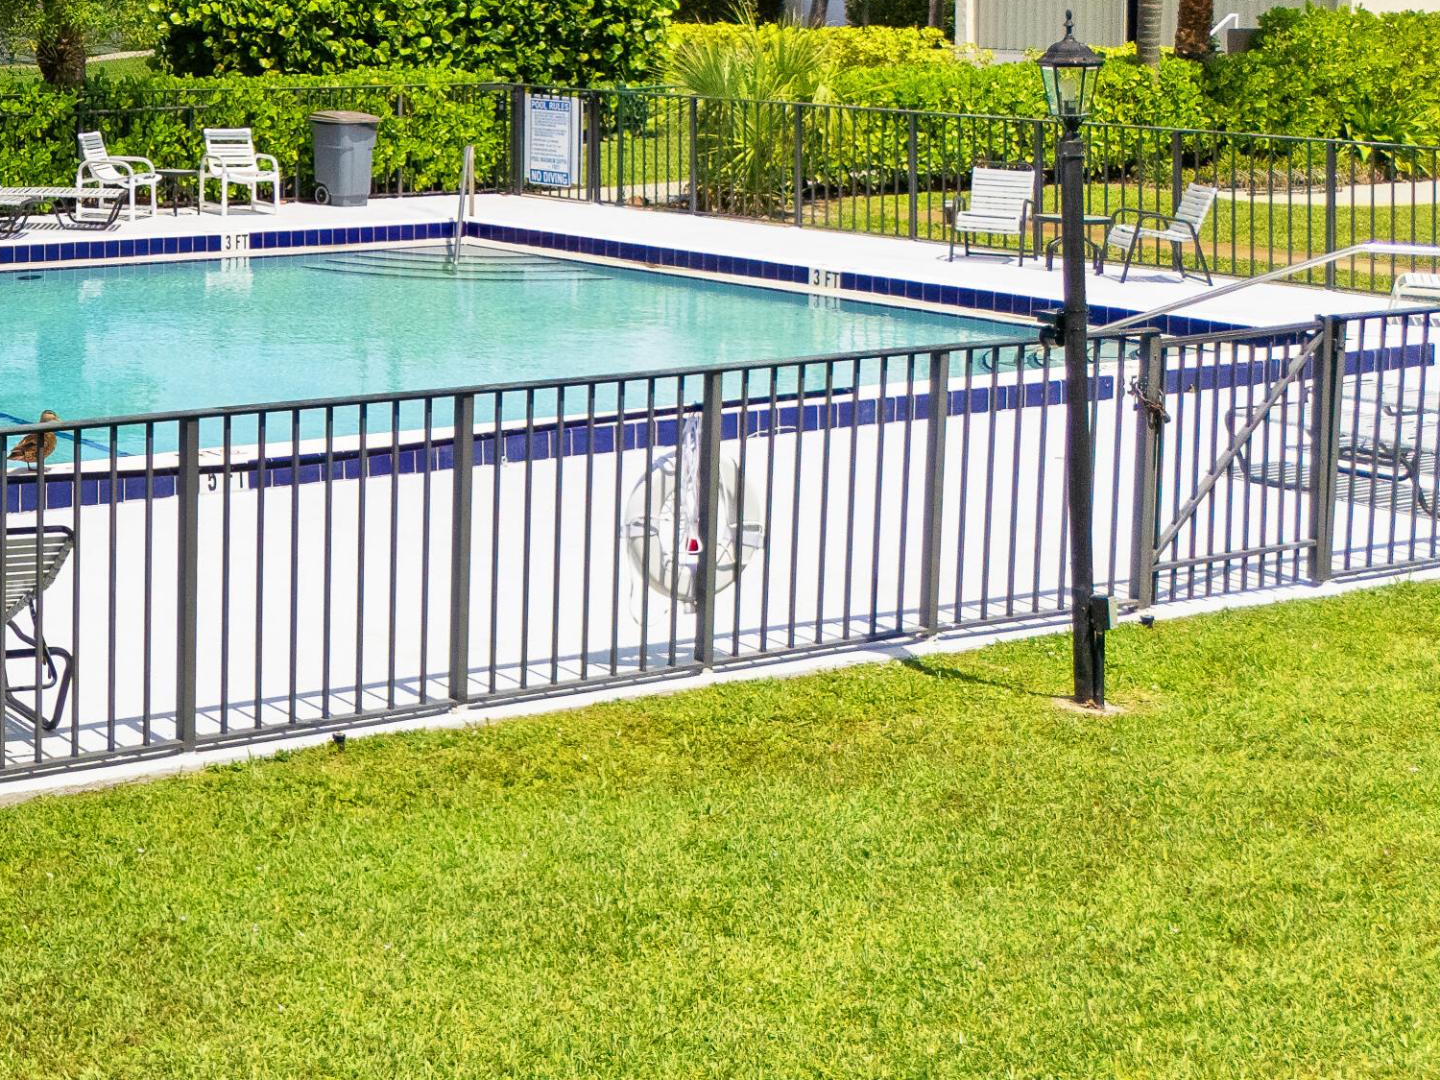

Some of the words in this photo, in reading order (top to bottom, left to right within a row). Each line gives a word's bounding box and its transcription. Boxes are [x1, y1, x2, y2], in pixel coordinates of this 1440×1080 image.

[531, 100, 546, 110] POOL
[549, 101, 569, 111] RULES
[531, 170, 542, 182] NO
[543, 171, 568, 185] DIVING
[225, 235, 231, 250] 3
[235, 234, 249, 250] FT
[813, 269, 820, 286] 3
[824, 270, 840, 289] FT
